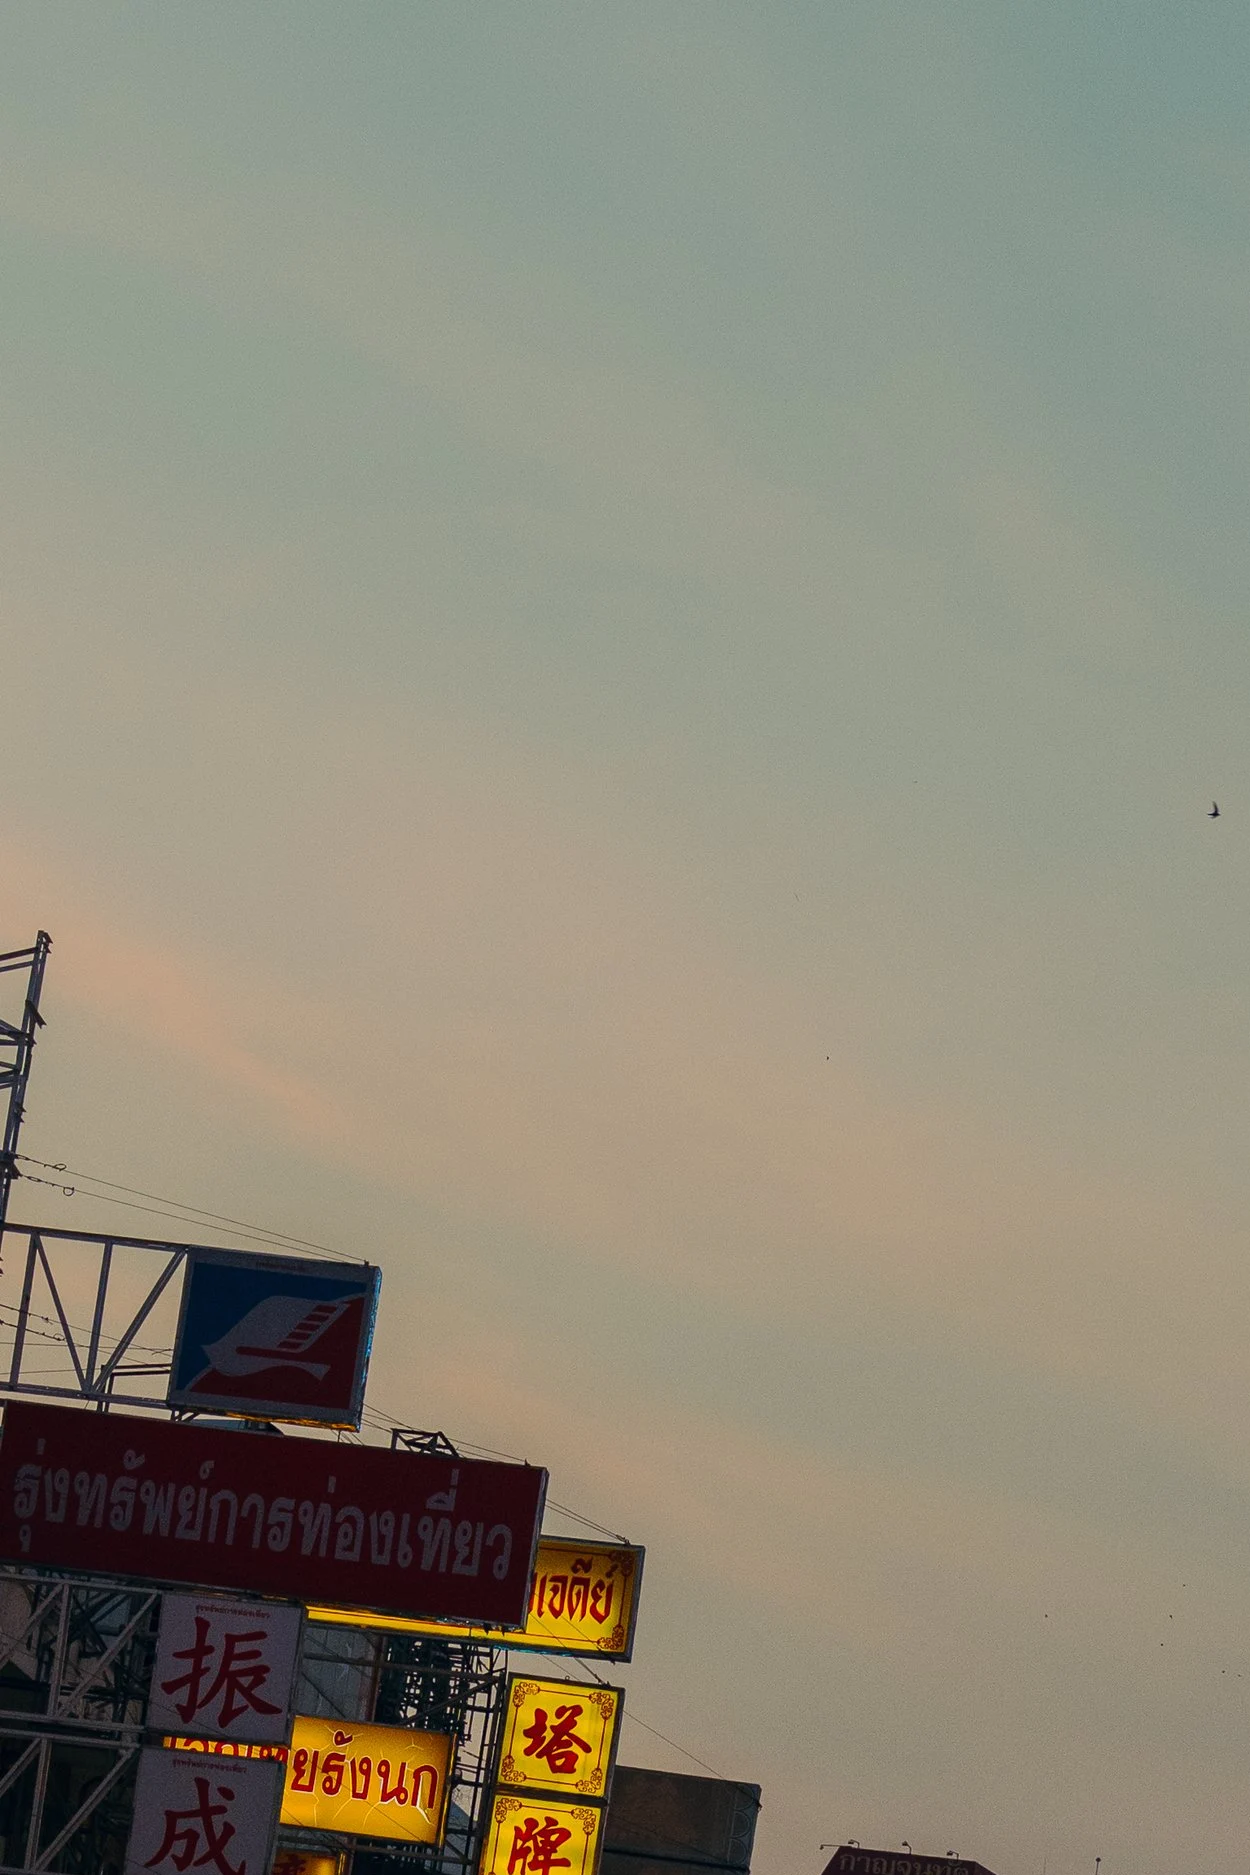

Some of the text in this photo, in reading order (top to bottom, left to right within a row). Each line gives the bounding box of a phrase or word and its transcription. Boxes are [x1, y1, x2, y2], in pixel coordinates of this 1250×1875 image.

[13, 1438, 513, 1580] รุ่งทรัพย์การท่องเที่ยว
[529, 1556, 616, 1625] เจดีย์
